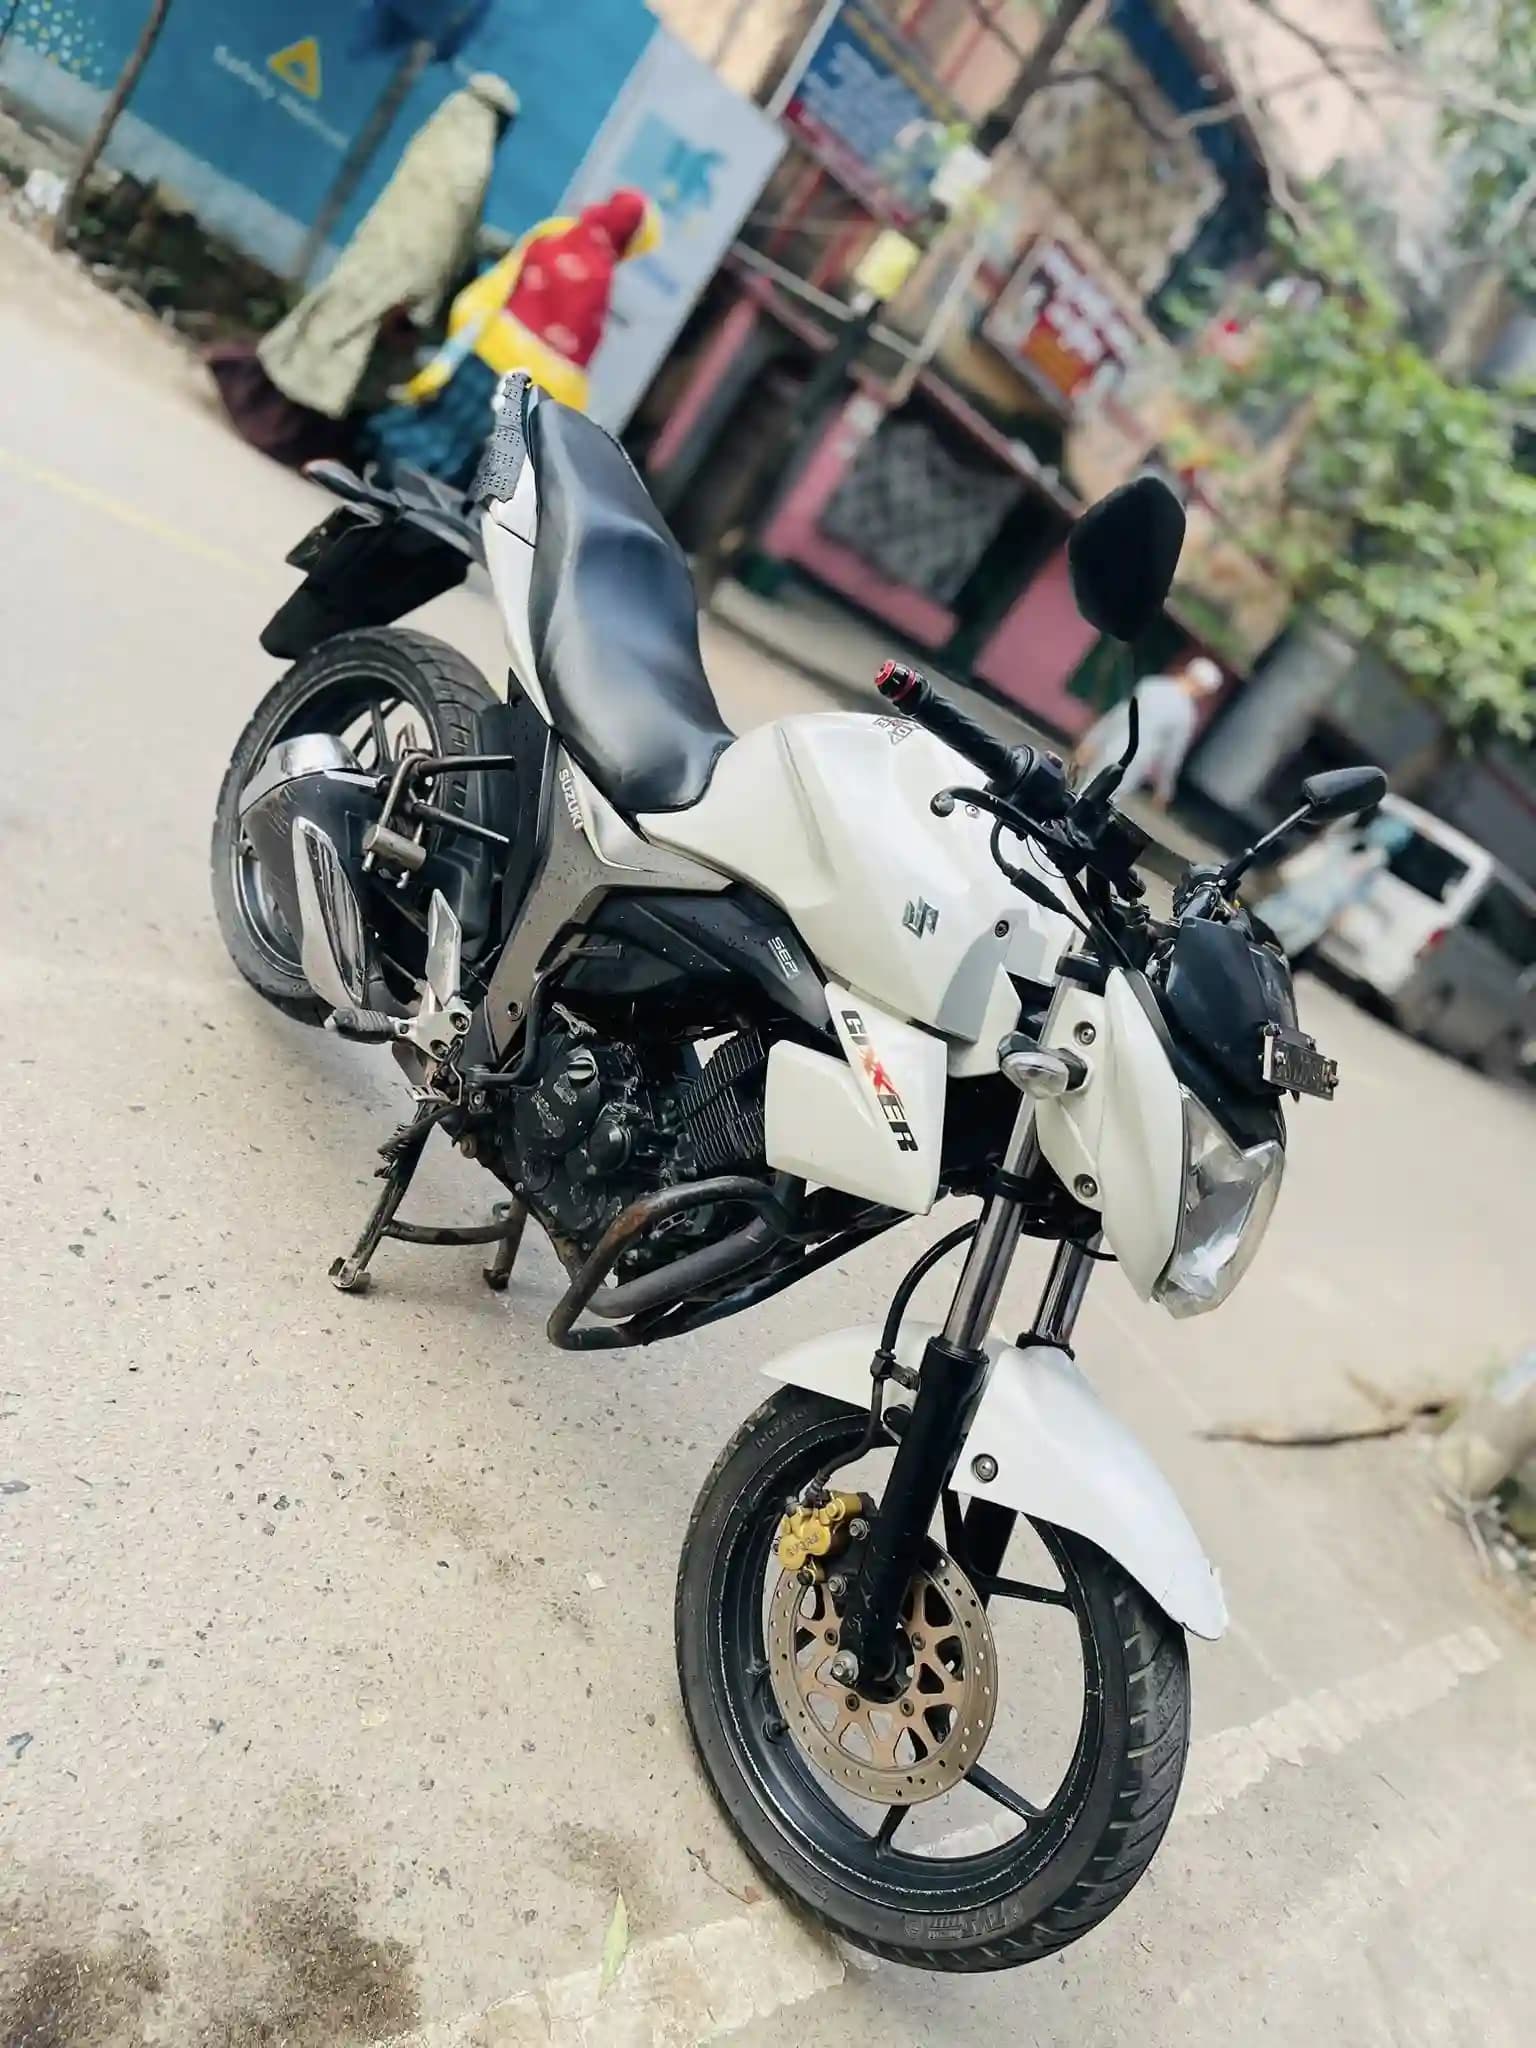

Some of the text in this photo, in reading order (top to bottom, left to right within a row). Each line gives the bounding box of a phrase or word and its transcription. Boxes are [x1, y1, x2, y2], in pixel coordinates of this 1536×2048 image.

[559, 768, 584, 831] SUZUKI
[771, 936, 799, 973] SEP
[841, 1010, 919, 1151] GIXXER
